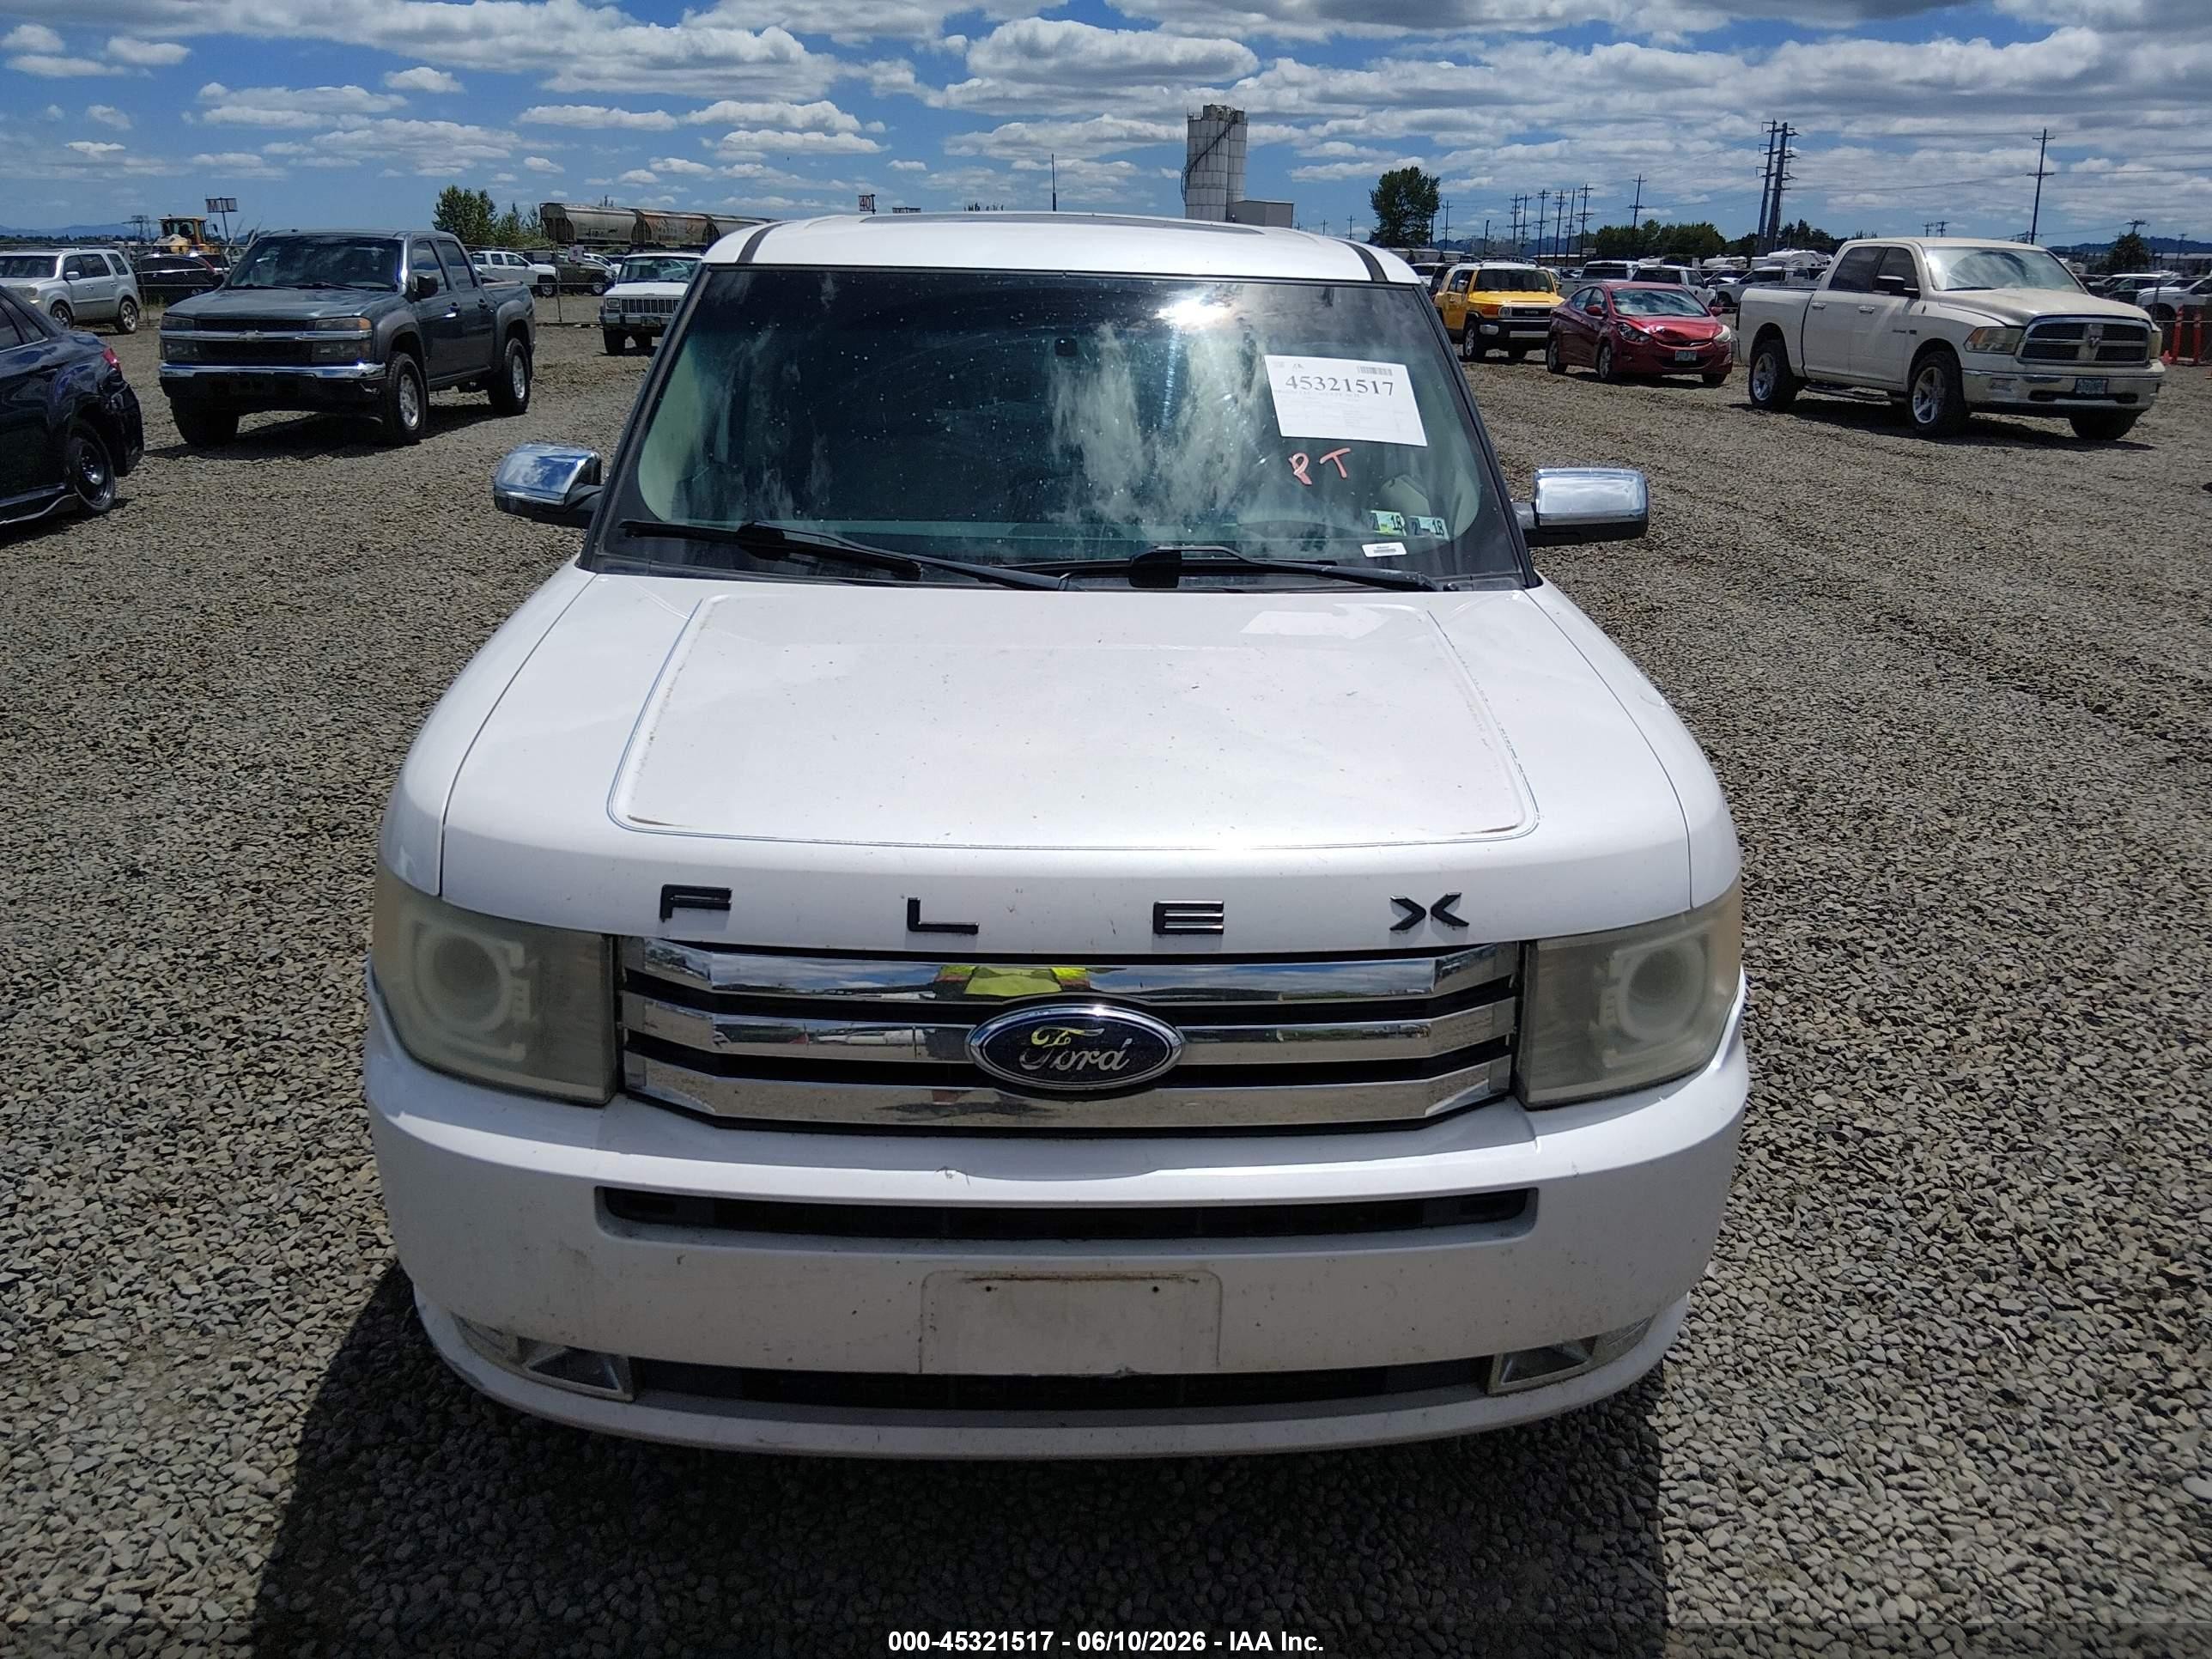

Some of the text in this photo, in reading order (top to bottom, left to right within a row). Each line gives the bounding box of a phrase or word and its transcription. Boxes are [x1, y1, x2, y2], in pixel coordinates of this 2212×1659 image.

[1285, 375, 1395, 397] 45321517
[659, 884, 1471, 935] FLEX
[1018, 1024, 1133, 1072] Ford
